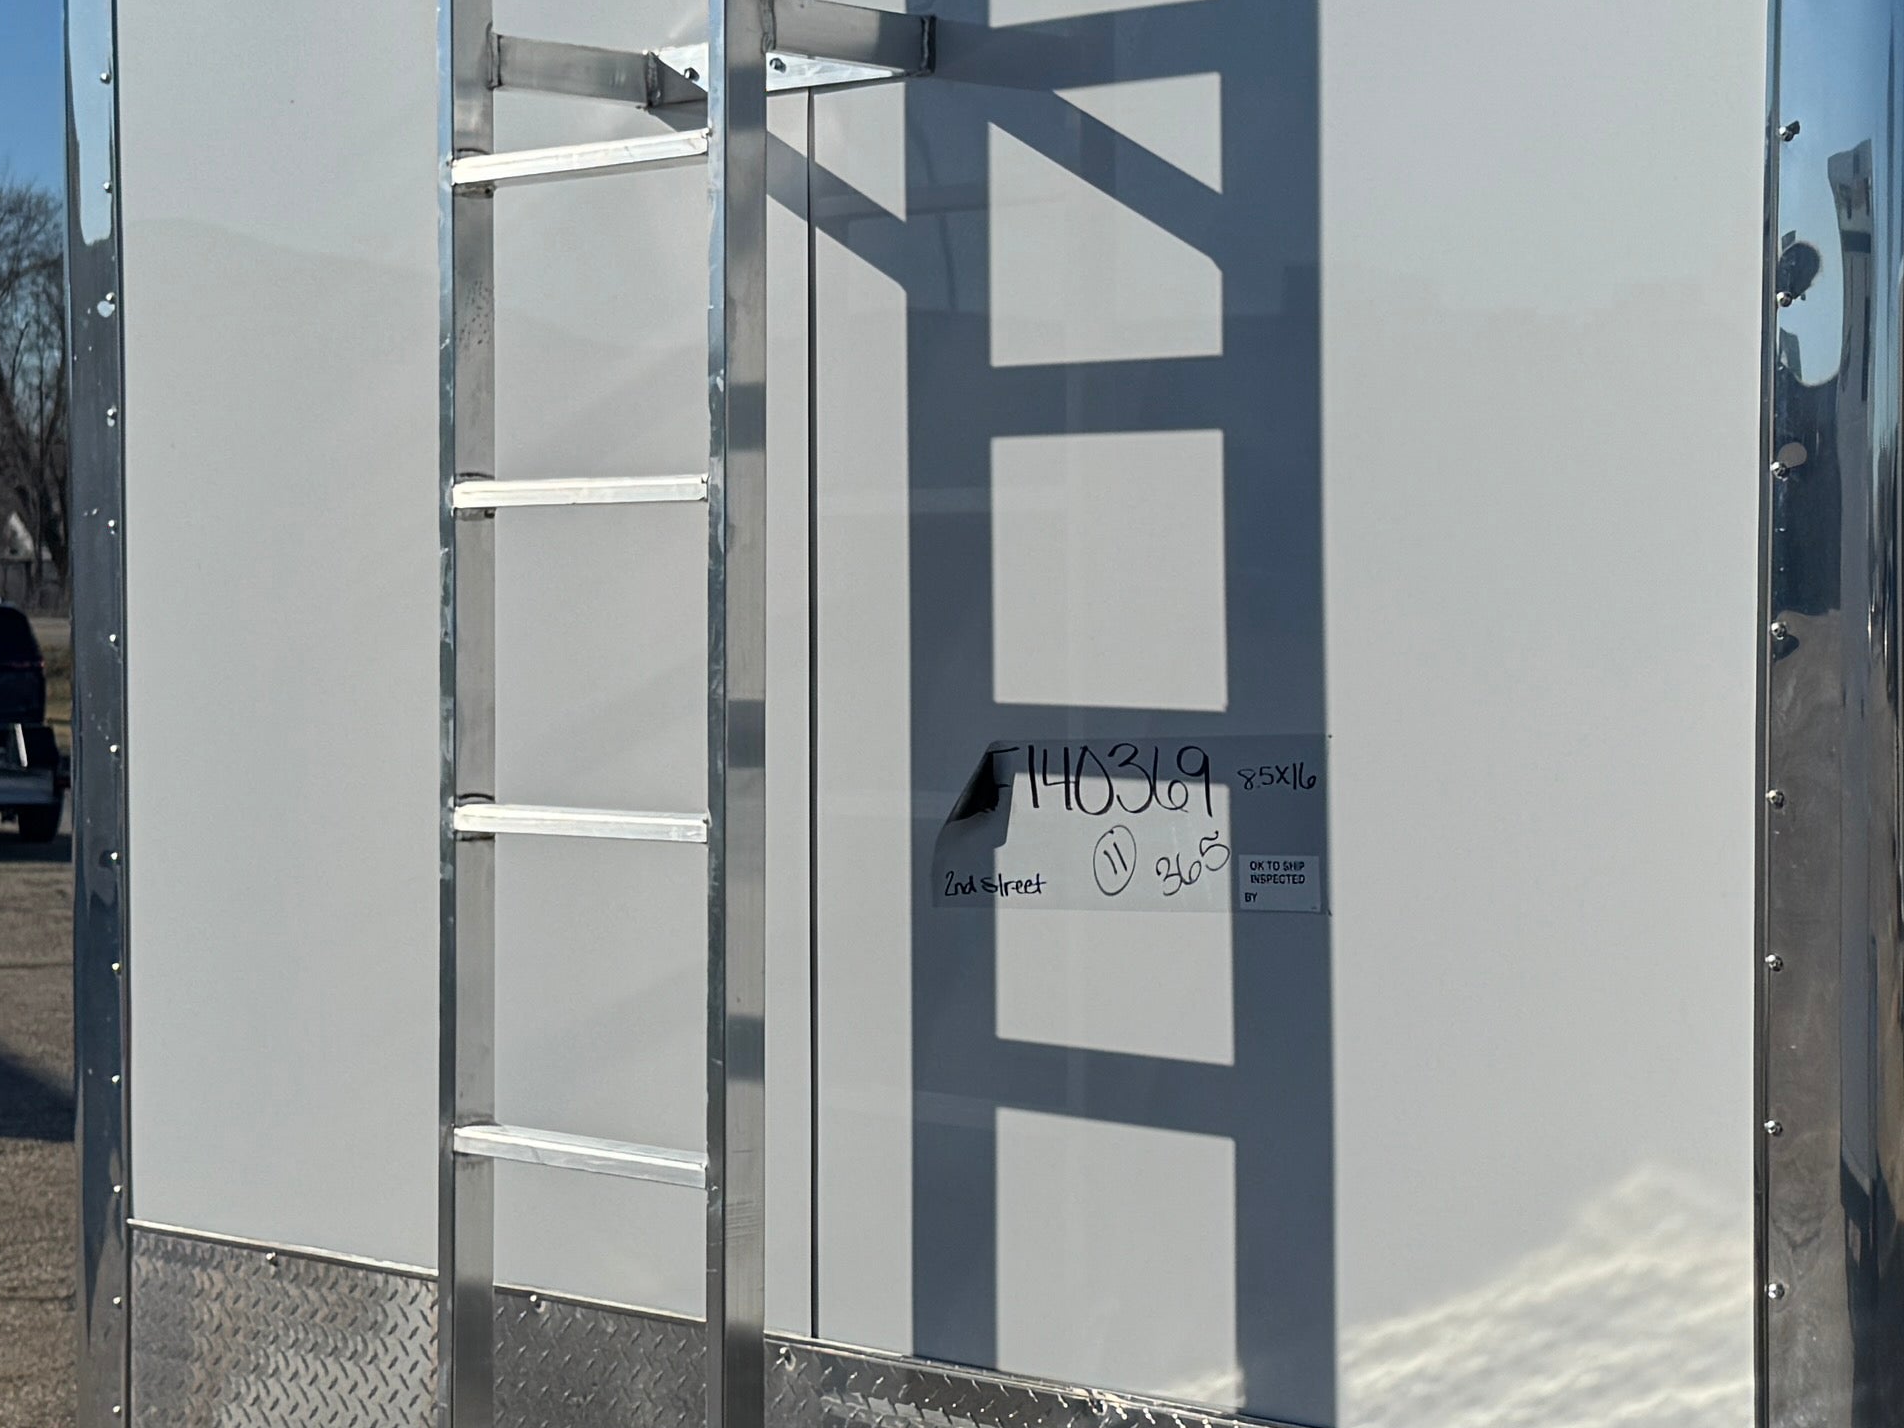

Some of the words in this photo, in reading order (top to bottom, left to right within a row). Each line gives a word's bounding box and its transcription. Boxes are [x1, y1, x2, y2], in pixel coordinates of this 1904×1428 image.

[1156, 830, 1231, 897] 365
[1249, 860, 1265, 871] OK
[1267, 860, 1280, 871] TO
[1283, 860, 1305, 872] SHIP
[1250, 874, 1306, 885] INSPECTED
[1244, 892, 1258, 903] BY
